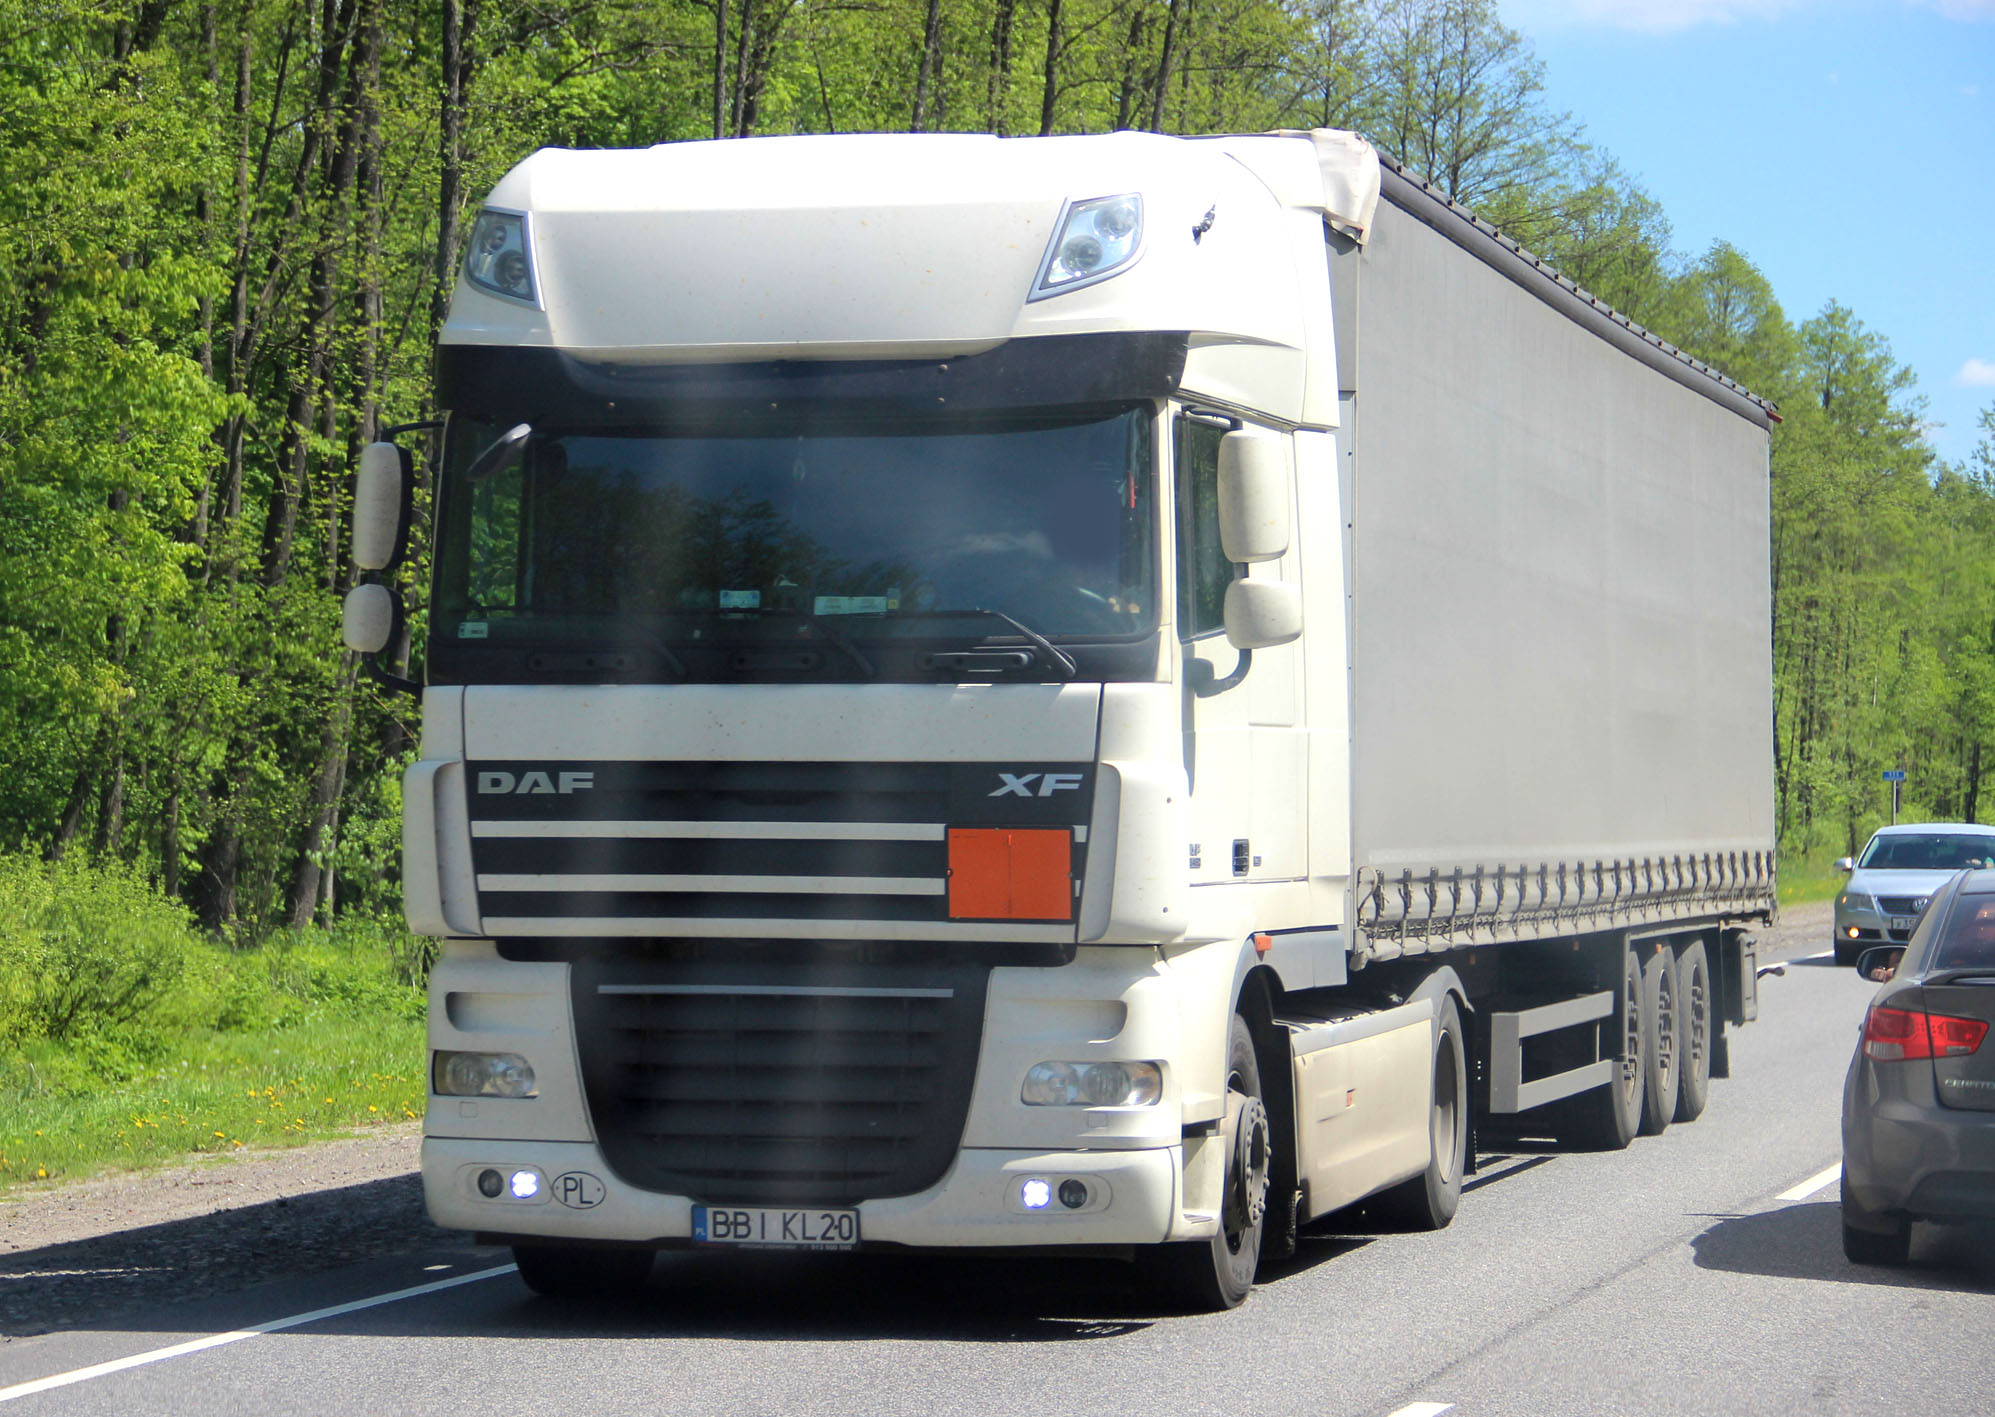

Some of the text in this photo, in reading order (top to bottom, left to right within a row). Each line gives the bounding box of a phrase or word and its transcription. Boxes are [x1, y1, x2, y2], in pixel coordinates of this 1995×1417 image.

[478, 771, 594, 794] DAF
[987, 773, 1084, 797] XF
[564, 1176, 593, 1204] PL
[782, 1211, 853, 1241] KL20
